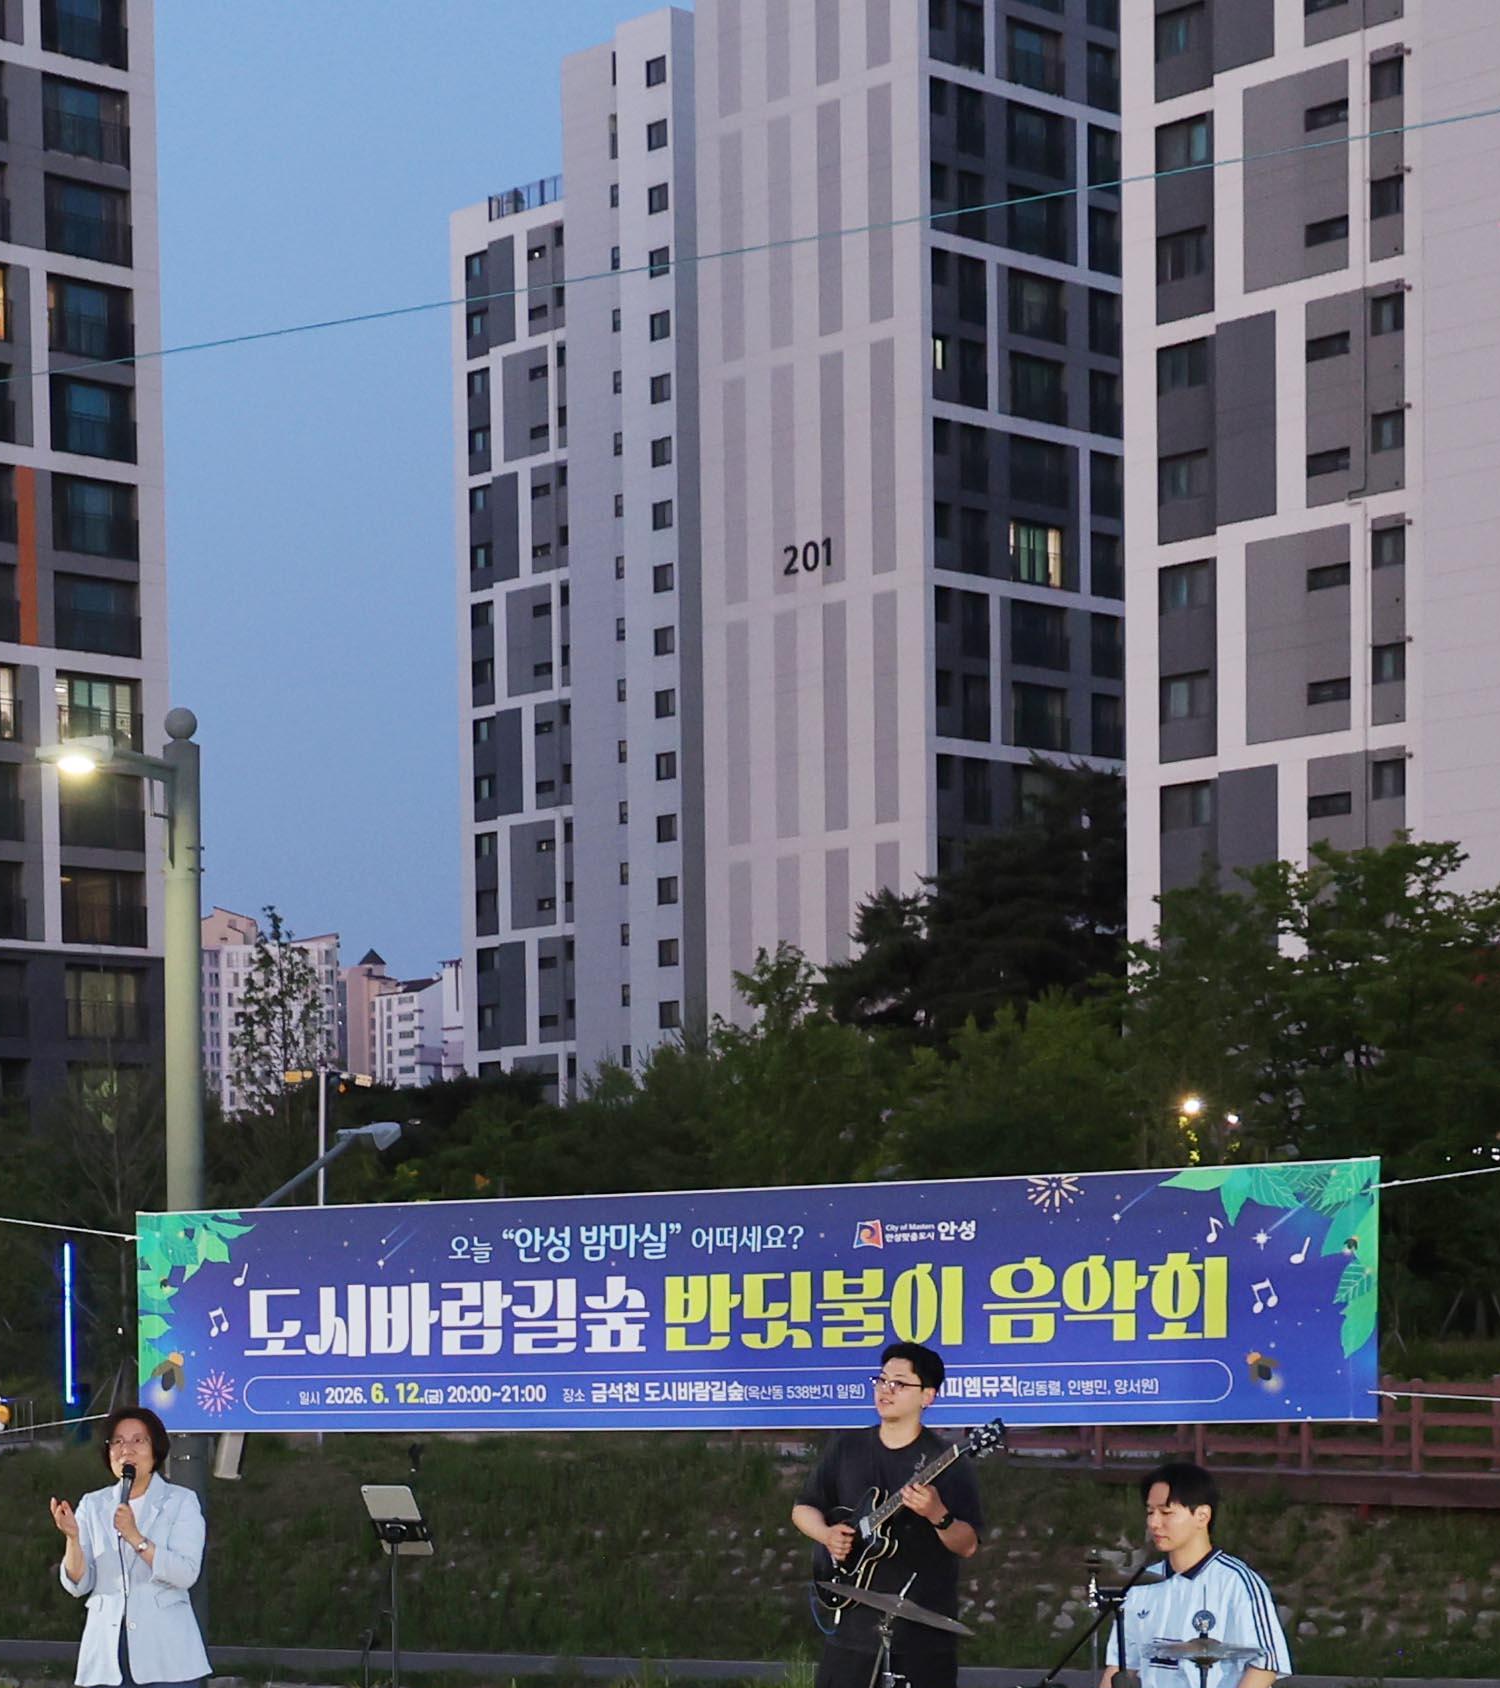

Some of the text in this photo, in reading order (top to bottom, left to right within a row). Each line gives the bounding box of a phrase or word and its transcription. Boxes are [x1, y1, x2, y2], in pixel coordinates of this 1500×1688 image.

[783, 536, 832, 577] 201
[448, 1236, 494, 1264] 오늘
[691, 1224, 805, 1255] 어떠세요?
[937, 1219, 977, 1242] 안성
[243, 1253, 1229, 1358] 도시바람길숲 반딧불이 음악회
[299, 1391, 320, 1406] 일시
[325, 1386, 368, 1405] 2026.
[446, 1384, 547, 1404] 20:00~21:00
[562, 1387, 586, 1403] 장소
[590, 1381, 640, 1403] 금석천
[786, 1383, 834, 1401] 538번지
[836, 1382, 866, 1401] 일원)
